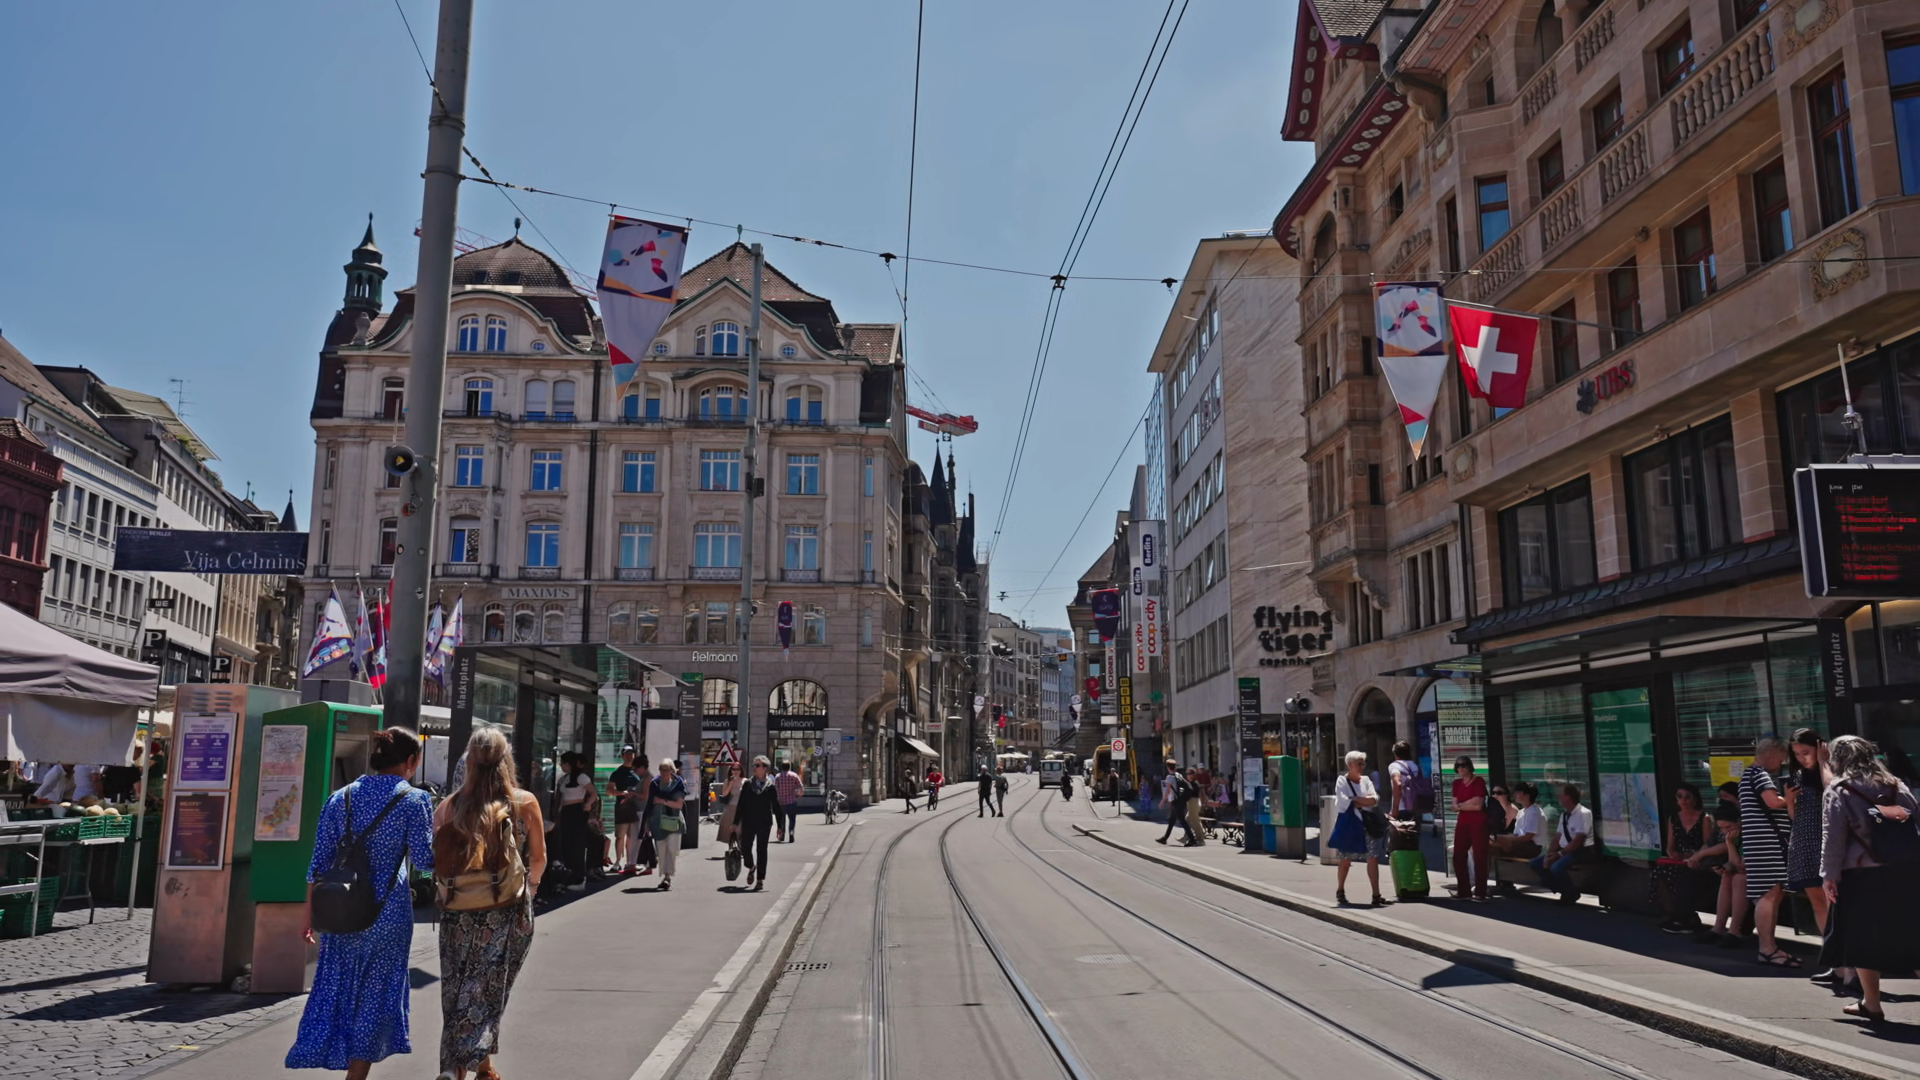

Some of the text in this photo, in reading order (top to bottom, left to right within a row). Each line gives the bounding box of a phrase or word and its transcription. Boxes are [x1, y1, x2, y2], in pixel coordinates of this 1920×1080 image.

[1594, 359, 1636, 400] UBS
[184, 551, 306, 571] Vija Celmins
[508, 588, 570, 598] MAXIM'S
[1145, 598, 1157, 654] coop city
[1253, 605, 1333, 633] flying
[1259, 628, 1333, 657] tiger
[1831, 632, 1845, 697] Marktplatz
[457, 658, 469, 709] Marktplatz
[701, 718, 730, 727] elmann
[1446, 735, 1472, 744] MUSIK
